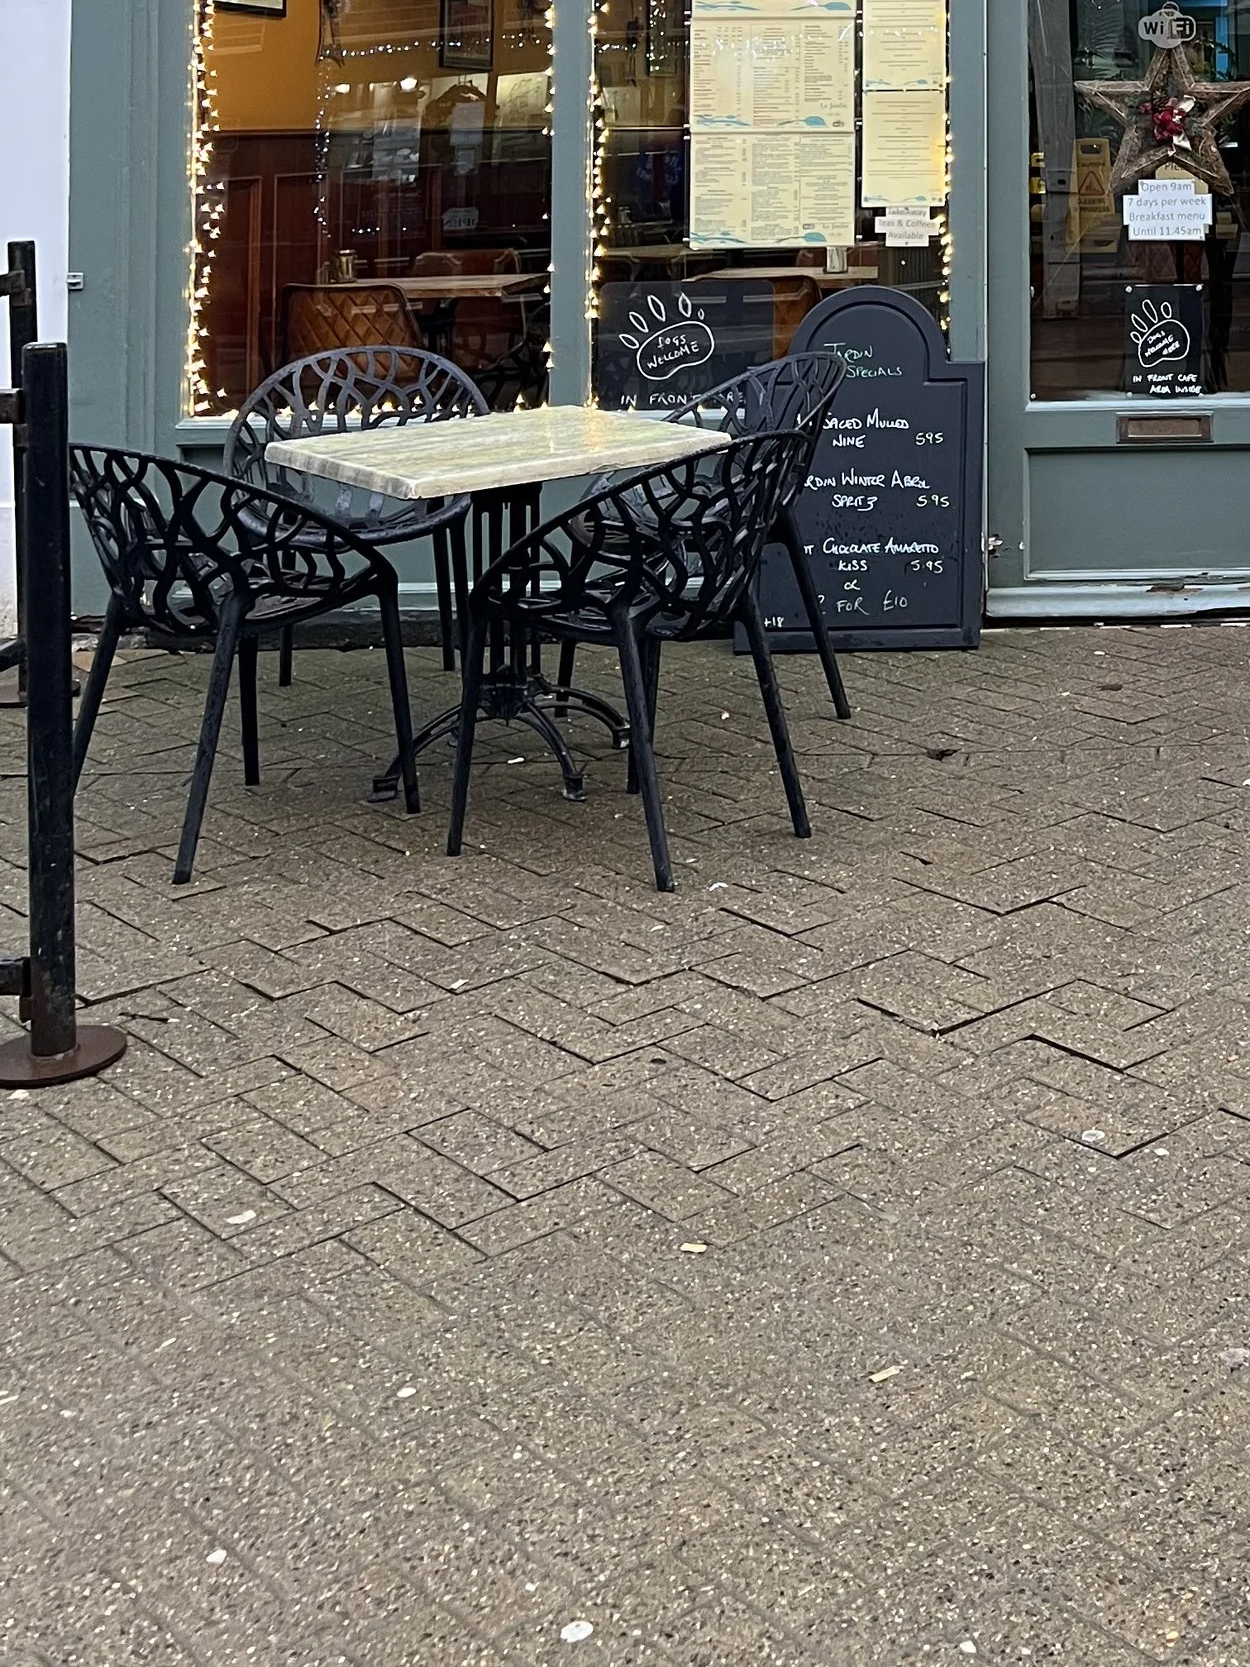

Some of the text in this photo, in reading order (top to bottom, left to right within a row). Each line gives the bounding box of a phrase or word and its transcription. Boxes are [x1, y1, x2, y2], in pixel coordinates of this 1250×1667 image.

[1141, 181, 1192, 193] Open 9am
[1127, 196, 1207, 208] 7 days per week
[1129, 212, 1206, 221] Breakfast menu
[878, 219, 936, 228] Teas & Coffees
[887, 231, 924, 239] Available
[1133, 226, 1201, 237] Until 11.45am
[646, 341, 701, 370] WELCOME
[845, 364, 903, 378] SPECIALS
[1132, 374, 1198, 383] IN FRONT CAFE
[1149, 384, 1202, 394] AREA INSIDE
[620, 394, 638, 407] IN
[841, 467, 886, 488] WINTER
[822, 536, 882, 555] CHOCOLATE
[884, 536, 940, 555] AMARETTO
[838, 559, 869, 572] KISS
[836, 596, 870, 615] FOR
[882, 589, 909, 612] £10
